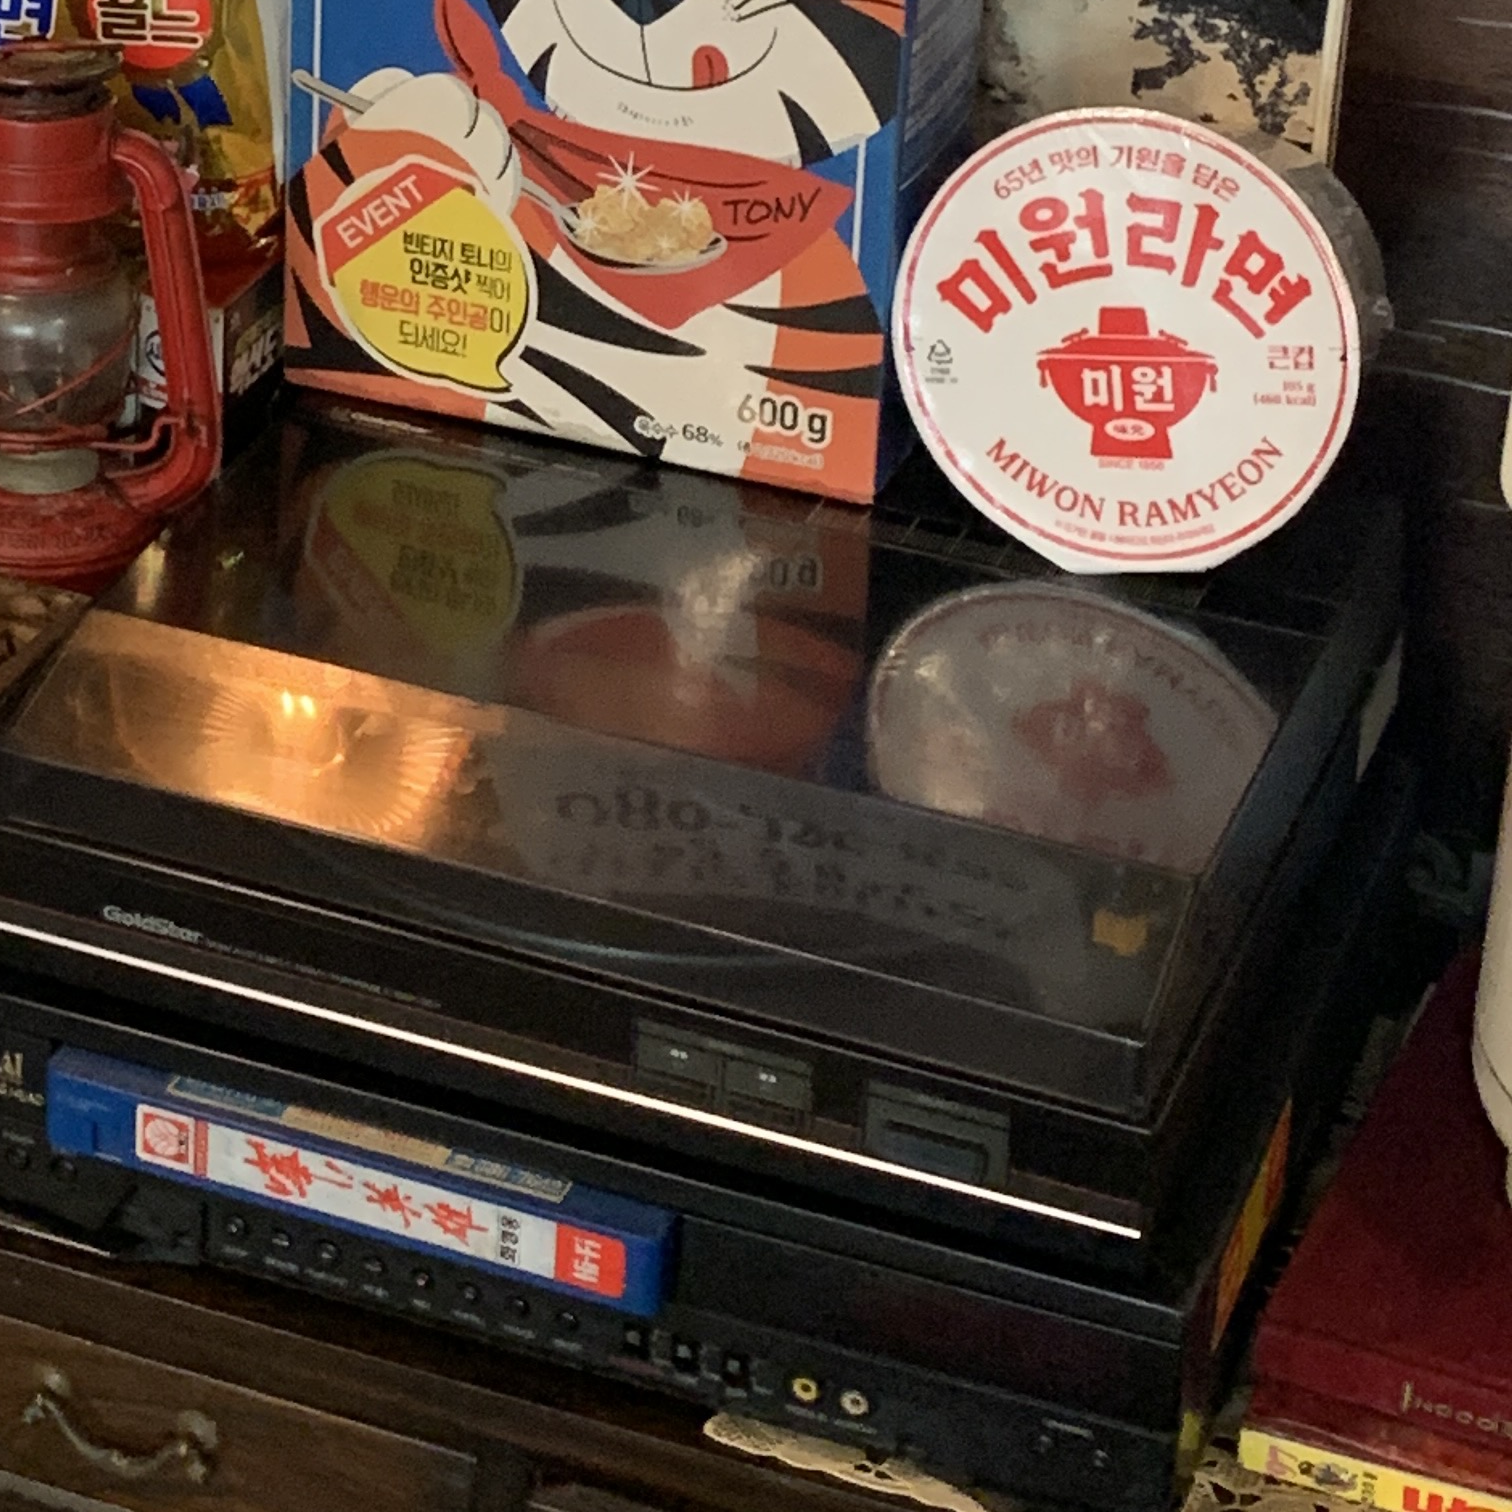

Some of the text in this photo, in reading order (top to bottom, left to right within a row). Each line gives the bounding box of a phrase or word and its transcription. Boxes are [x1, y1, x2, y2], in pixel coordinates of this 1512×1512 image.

[995, 146, 1240, 201] 65년 맛의 기원을 담은
[336, 175, 423, 248] EVENT
[722, 187, 821, 225] TONY
[402, 230, 513, 273] 빈티지 토니의
[409, 257, 471, 294] 인증샷
[936, 188, 1312, 339] 미원라면
[359, 279, 511, 335] 행운의 주인공이
[397, 320, 468, 358] 되세요!
[1080, 364, 1175, 413] 미원
[682, 424, 724, 448] 68%
[737, 393, 828, 444] 600 g
[986, 436, 1284, 528] MIWON RAMYEON
[102, 904, 203, 944] GoldStar
